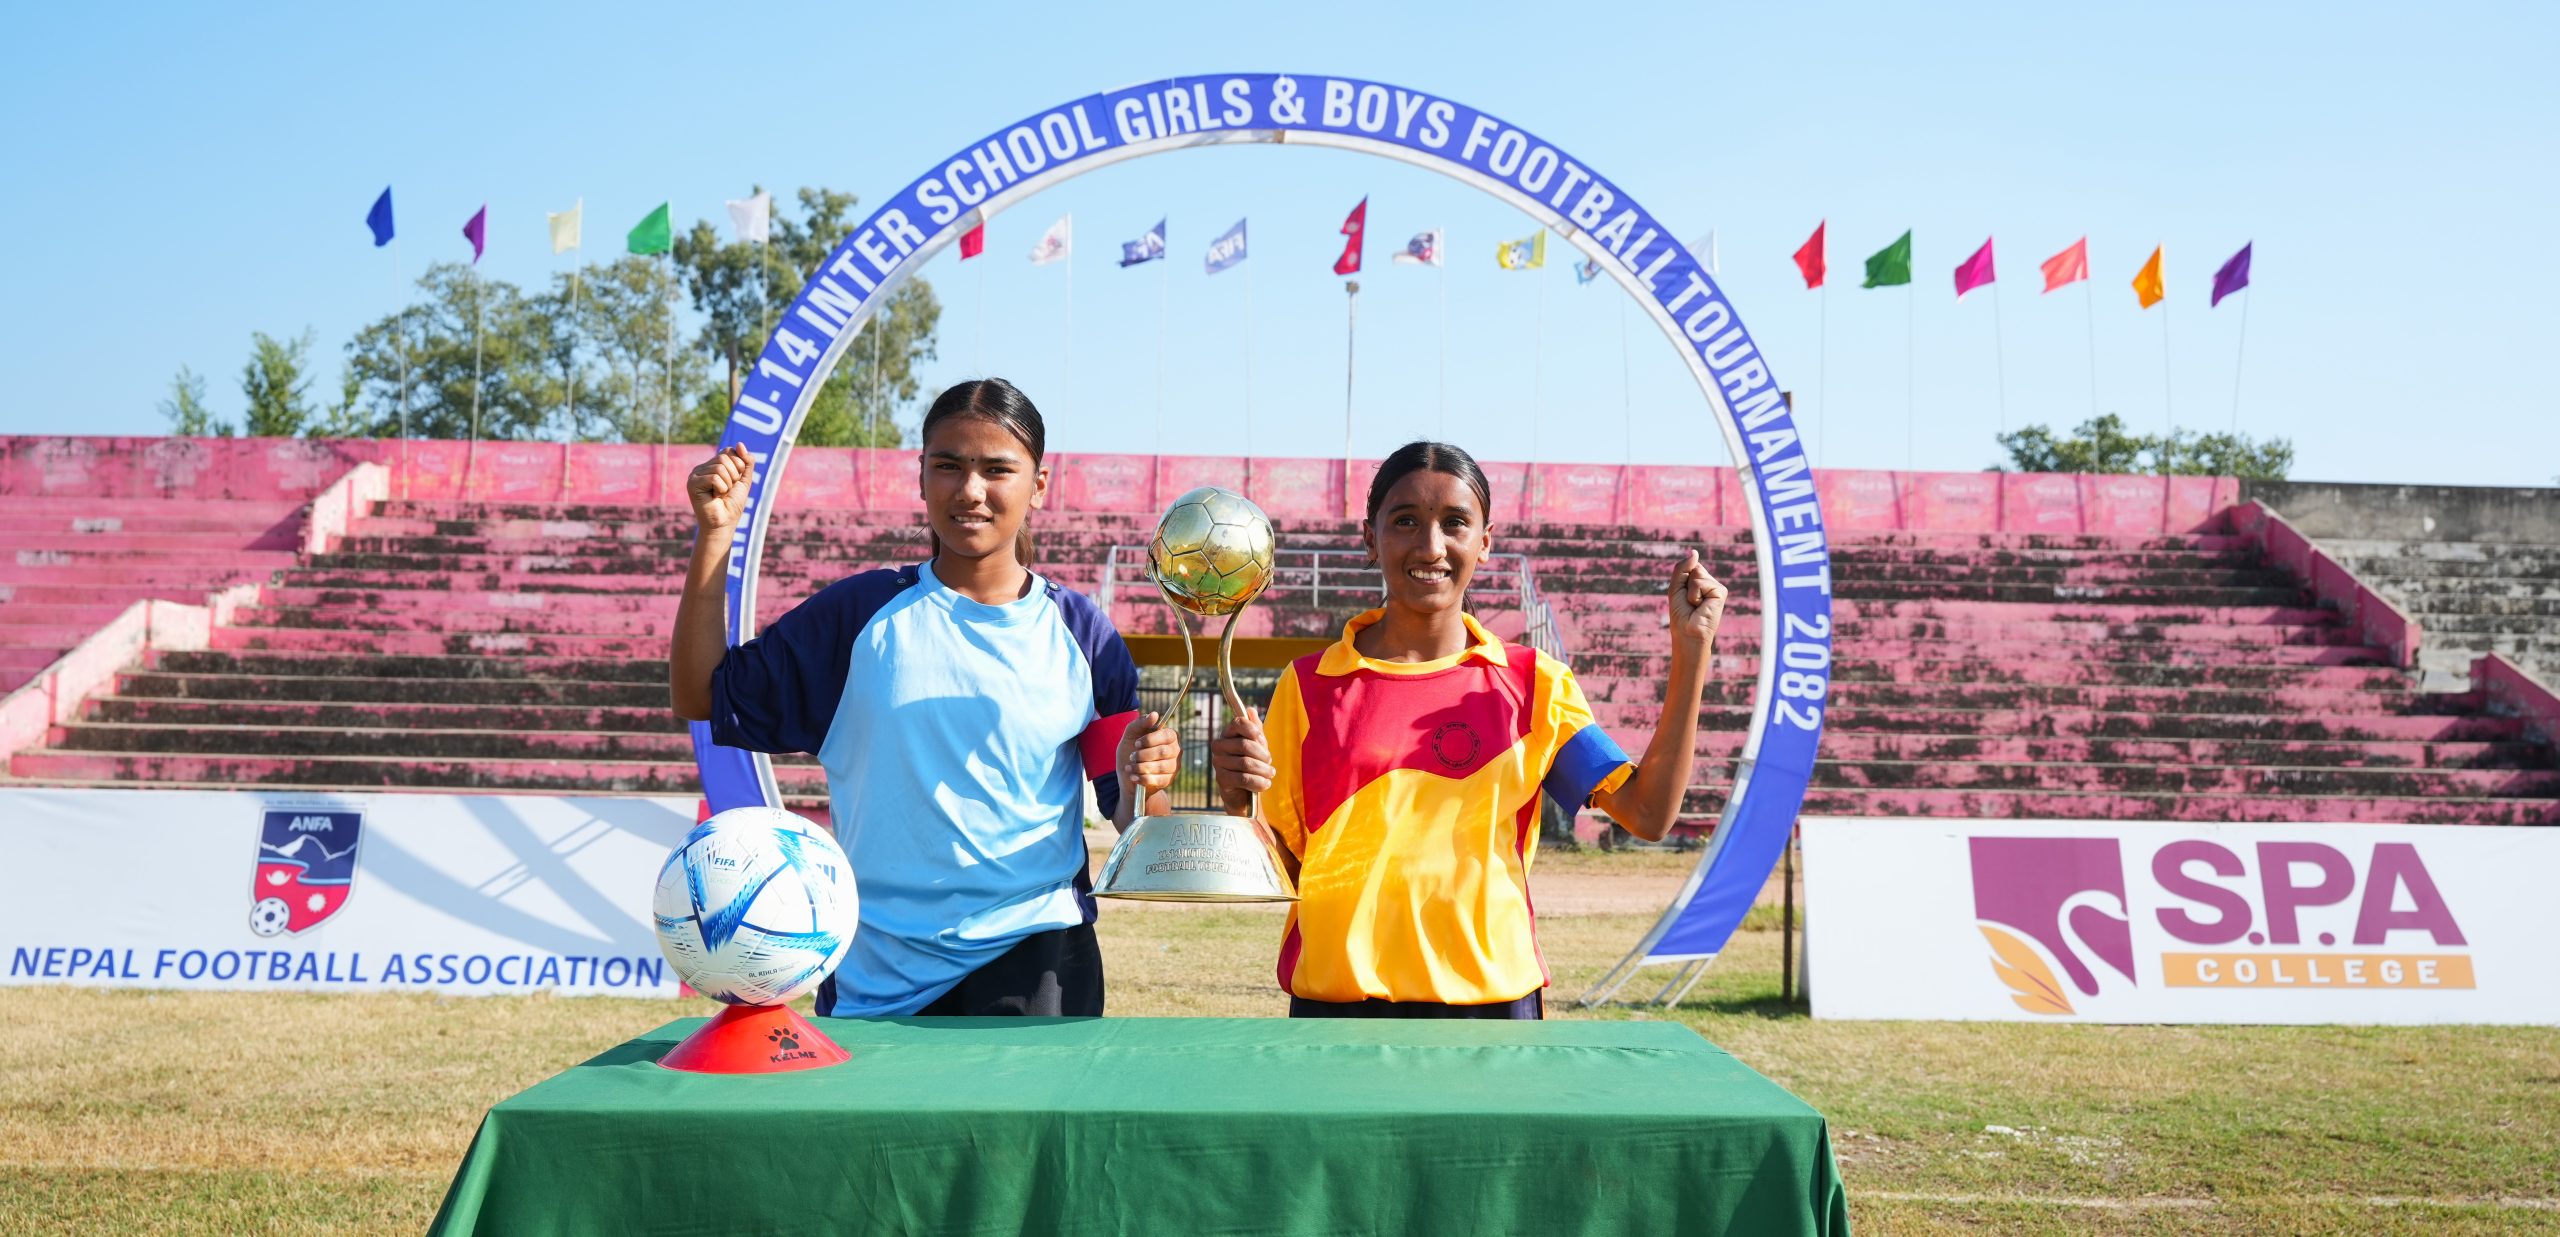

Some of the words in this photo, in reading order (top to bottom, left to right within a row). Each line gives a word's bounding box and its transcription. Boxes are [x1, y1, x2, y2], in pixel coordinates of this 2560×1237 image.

[732, 328, 820, 436] U-14
[796, 207, 926, 338] INTER
[916, 103, 1107, 226] SCHOOL
[1114, 77, 1254, 145] GIRLS
[1269, 75, 1307, 125] &
[1323, 79, 1456, 149] BOYS
[1461, 115, 1676, 292] FOOTBALL
[1665, 270, 1830, 596] TOURNAMENT
[1773, 613, 1831, 732] 2082
[288, 815, 333, 831] ANFA
[1169, 823, 1238, 849] ANFA
[714, 857, 735, 867] FIFA
[11, 947, 140, 979] NEPAL
[153, 949, 369, 983] FOOTBALL
[381, 952, 664, 988] ASSOCIATION
[2196, 958, 2441, 985] COLLEGE
[770, 1051, 817, 1063] KELME
